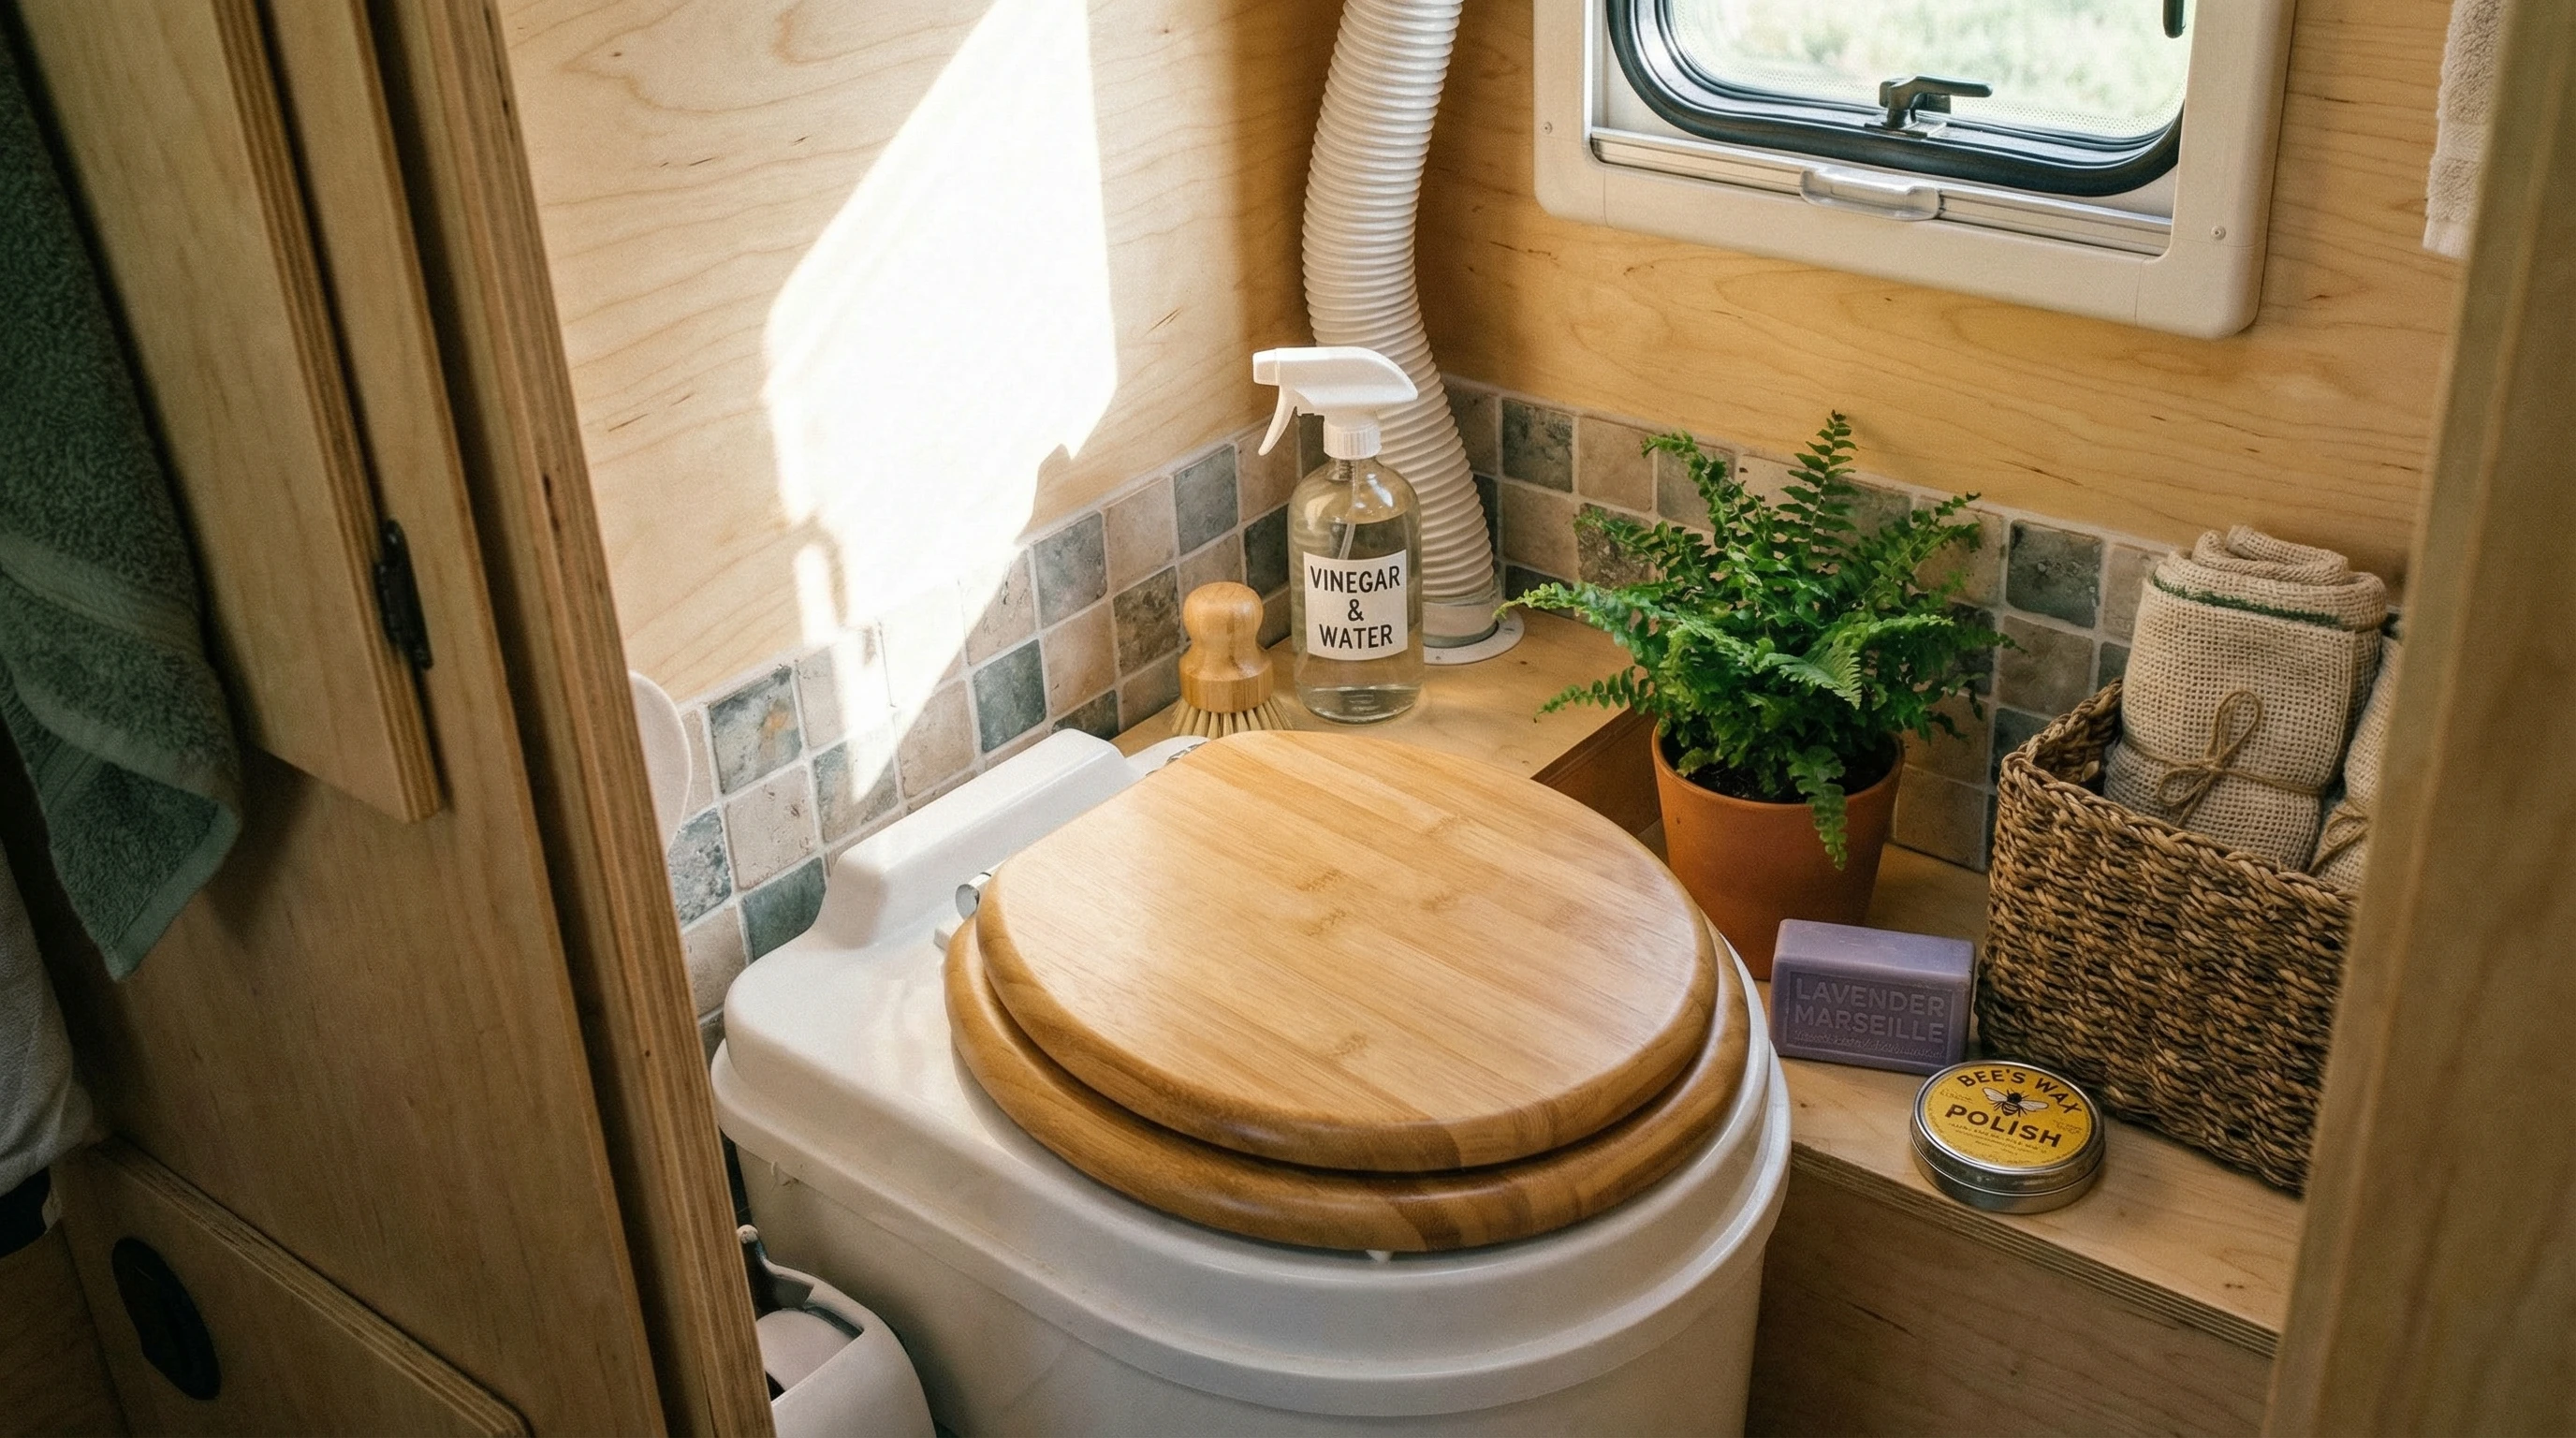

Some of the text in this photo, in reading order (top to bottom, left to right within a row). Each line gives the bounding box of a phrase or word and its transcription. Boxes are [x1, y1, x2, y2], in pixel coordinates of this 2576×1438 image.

[1310, 565, 1400, 594] VINEGAR
[1348, 598, 1364, 622] &
[1319, 624, 1393, 649] WATER
[1796, 978, 1945, 1018] LAVENDER
[1794, 1005, 1944, 1044] MARSEILLE
[1956, 1069, 2082, 1114] BEE'S WAX
[1945, 1104, 2062, 1148] POLISH
